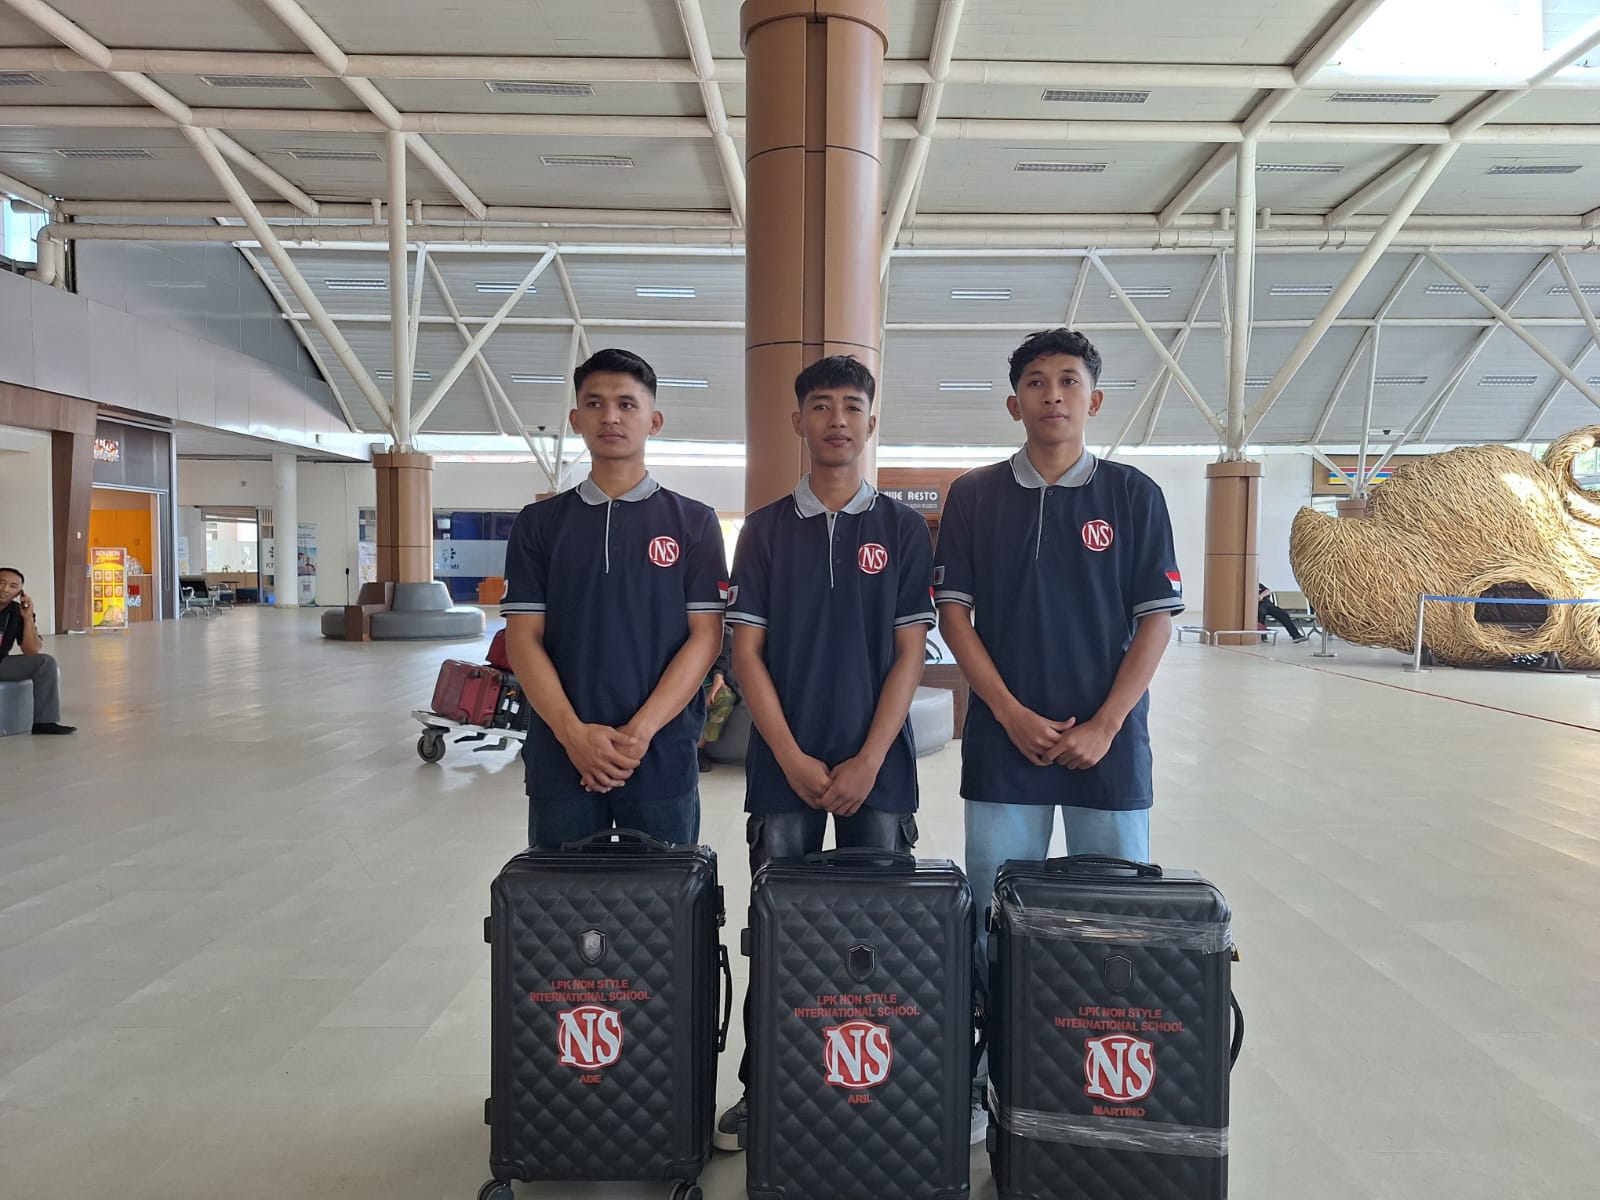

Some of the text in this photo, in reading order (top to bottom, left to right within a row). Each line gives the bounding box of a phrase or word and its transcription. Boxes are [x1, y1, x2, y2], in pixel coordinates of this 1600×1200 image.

[907, 491, 938, 501] RESTO
[1087, 523, 1110, 547] NS
[653, 539, 676, 563] NS
[861, 546, 886, 570] NS
[551, 979, 629, 989] LPK NON STYLE
[529, 990, 651, 1002] INTERNATIONAL SCHOOL
[817, 993, 897, 1005] LPK NON STYLE
[794, 1005, 921, 1018] INTERNATIONAL SCHOOL
[1078, 1006, 1162, 1019] LPK NON STYLE
[1055, 1017, 1185, 1032] INTERNATIONAL SCHOOL
[559, 1010, 621, 1064] NS
[826, 1027, 889, 1083] NS
[1087, 1040, 1152, 1098] NS
[579, 1075, 602, 1084] ADE
[848, 1094, 873, 1104] ARIL
[1092, 1105, 1146, 1117] MARTINO
